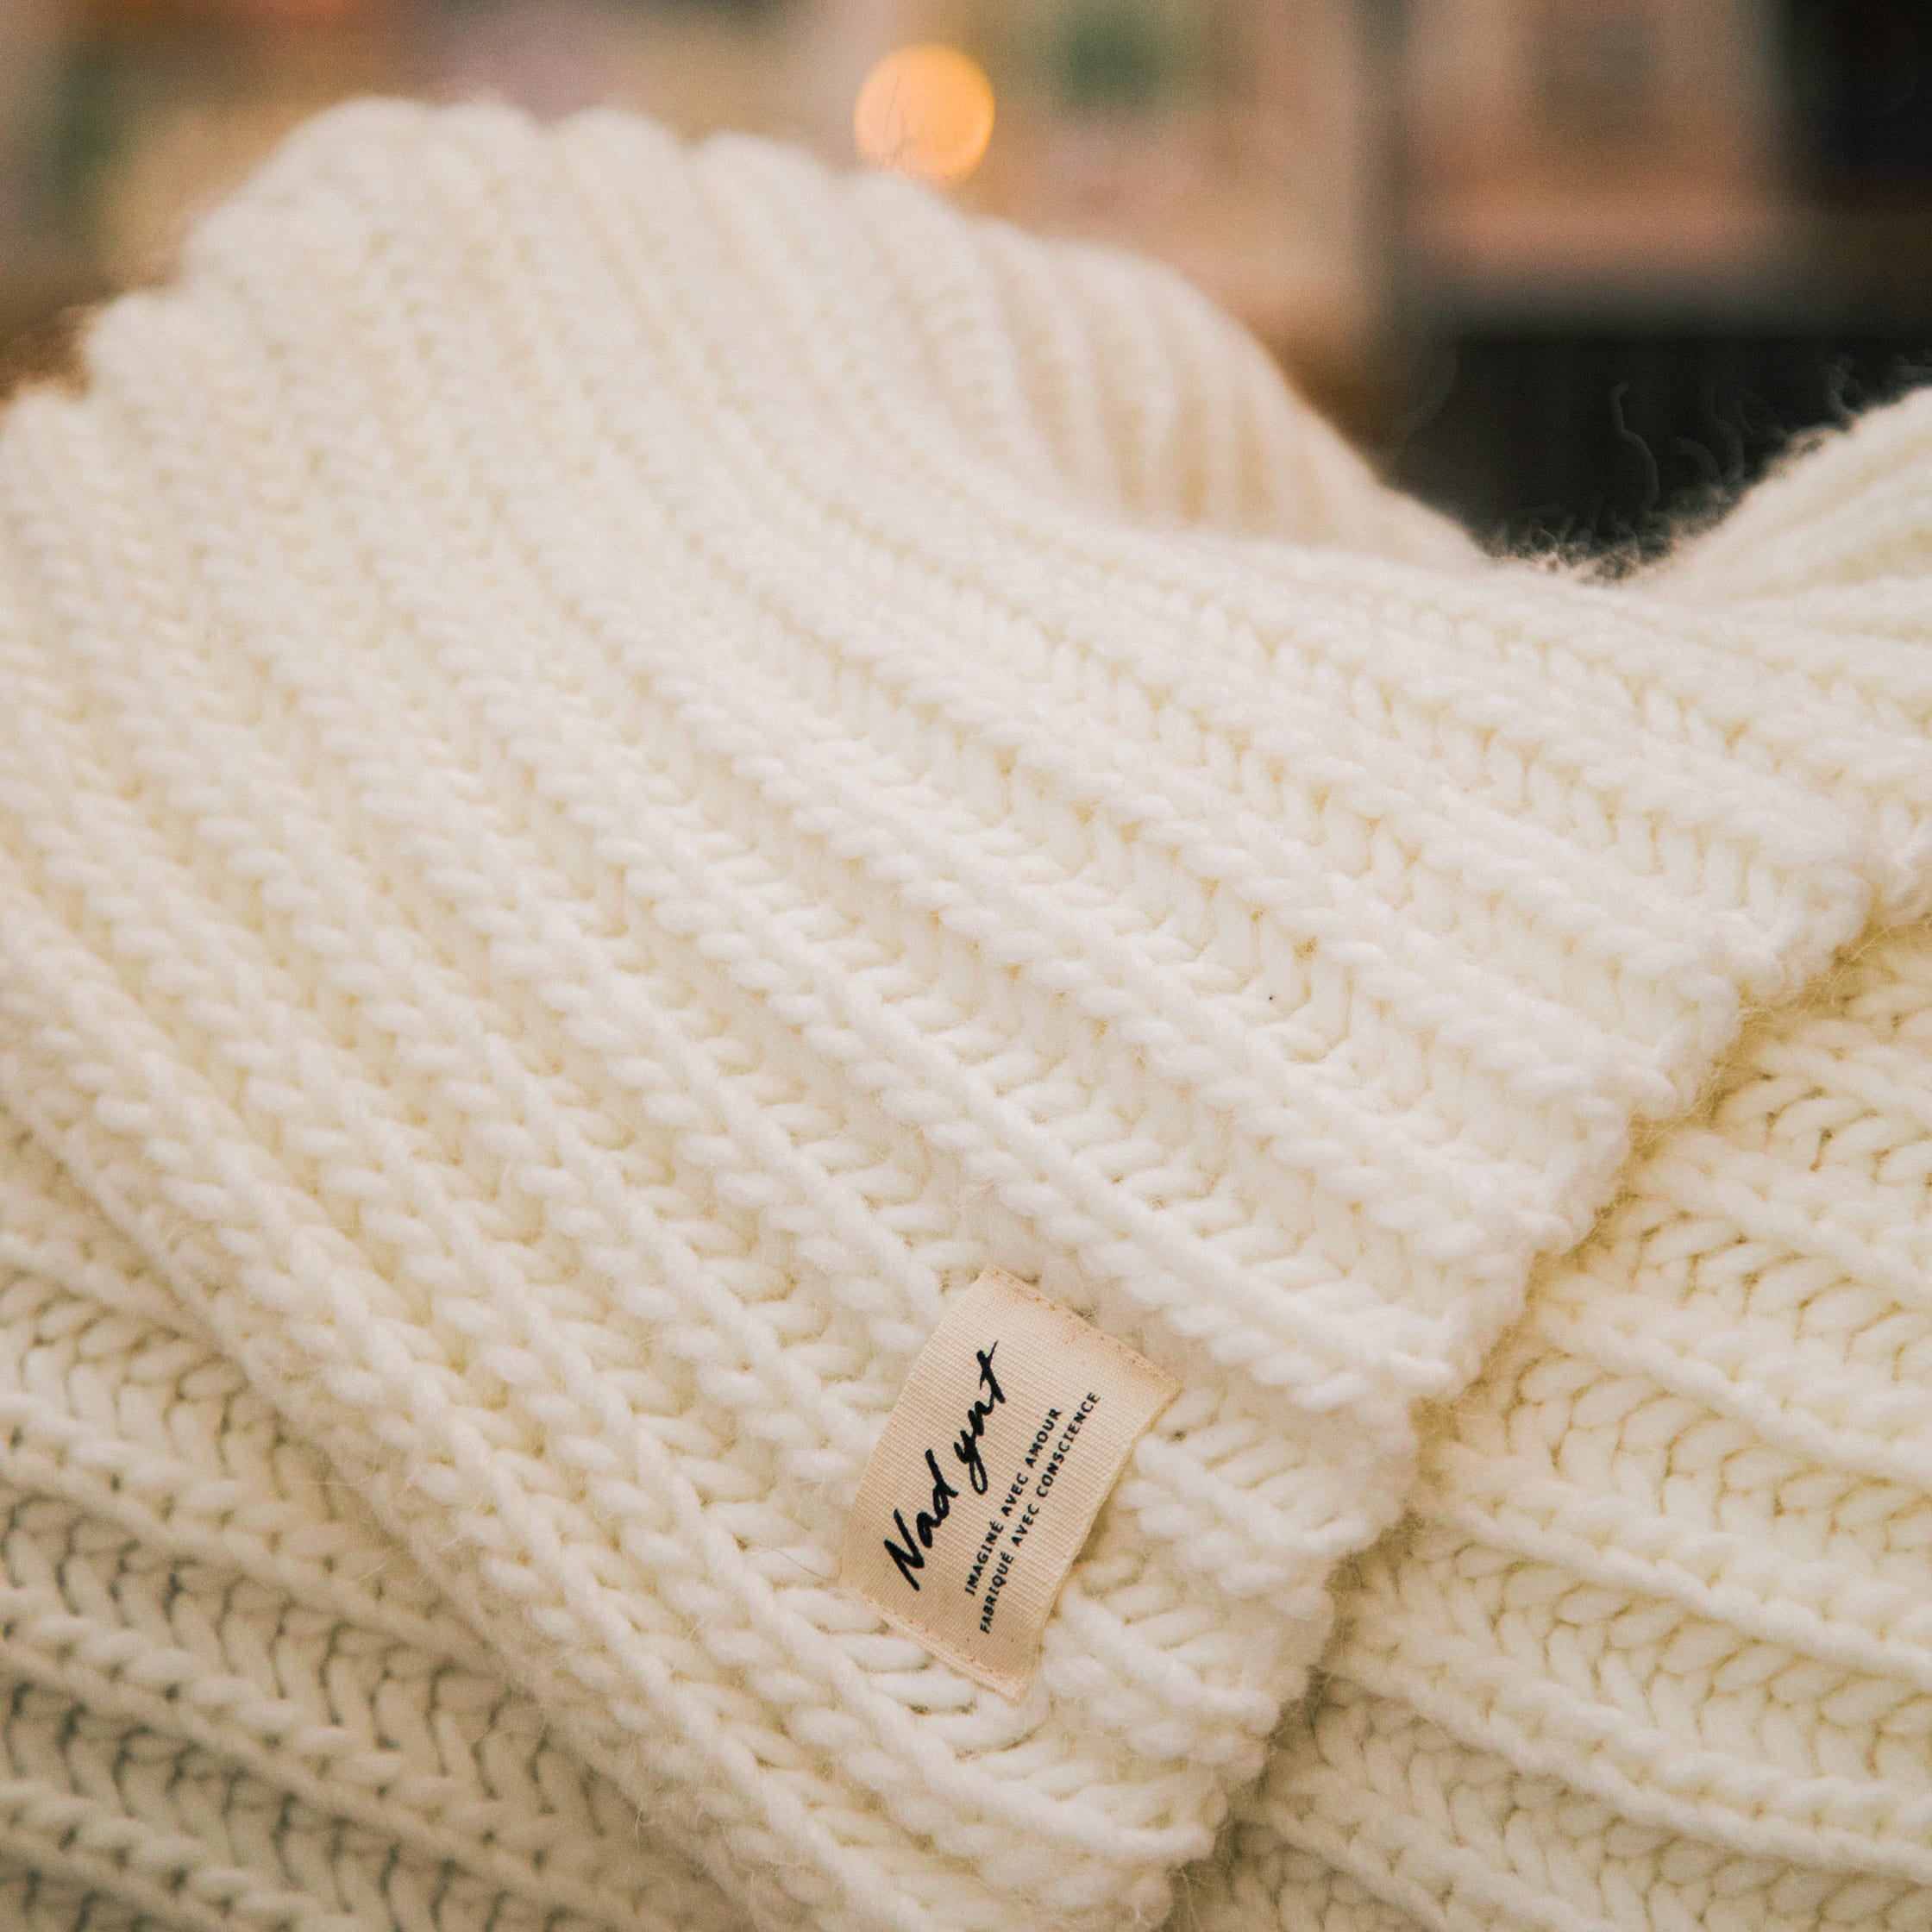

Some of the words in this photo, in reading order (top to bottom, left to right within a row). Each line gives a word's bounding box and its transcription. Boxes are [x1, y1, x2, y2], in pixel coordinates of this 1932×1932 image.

[964, 1521, 1004, 1597] IMAGINÉ
[1000, 1471, 1029, 1517] AVEC
[1025, 1408, 1062, 1469] AMOUR
[979, 1551, 1014, 1634] FABRIQUÉ
[1011, 1503, 1040, 1547] AVEC
[1036, 1391, 1100, 1498] CONSCIENCE
